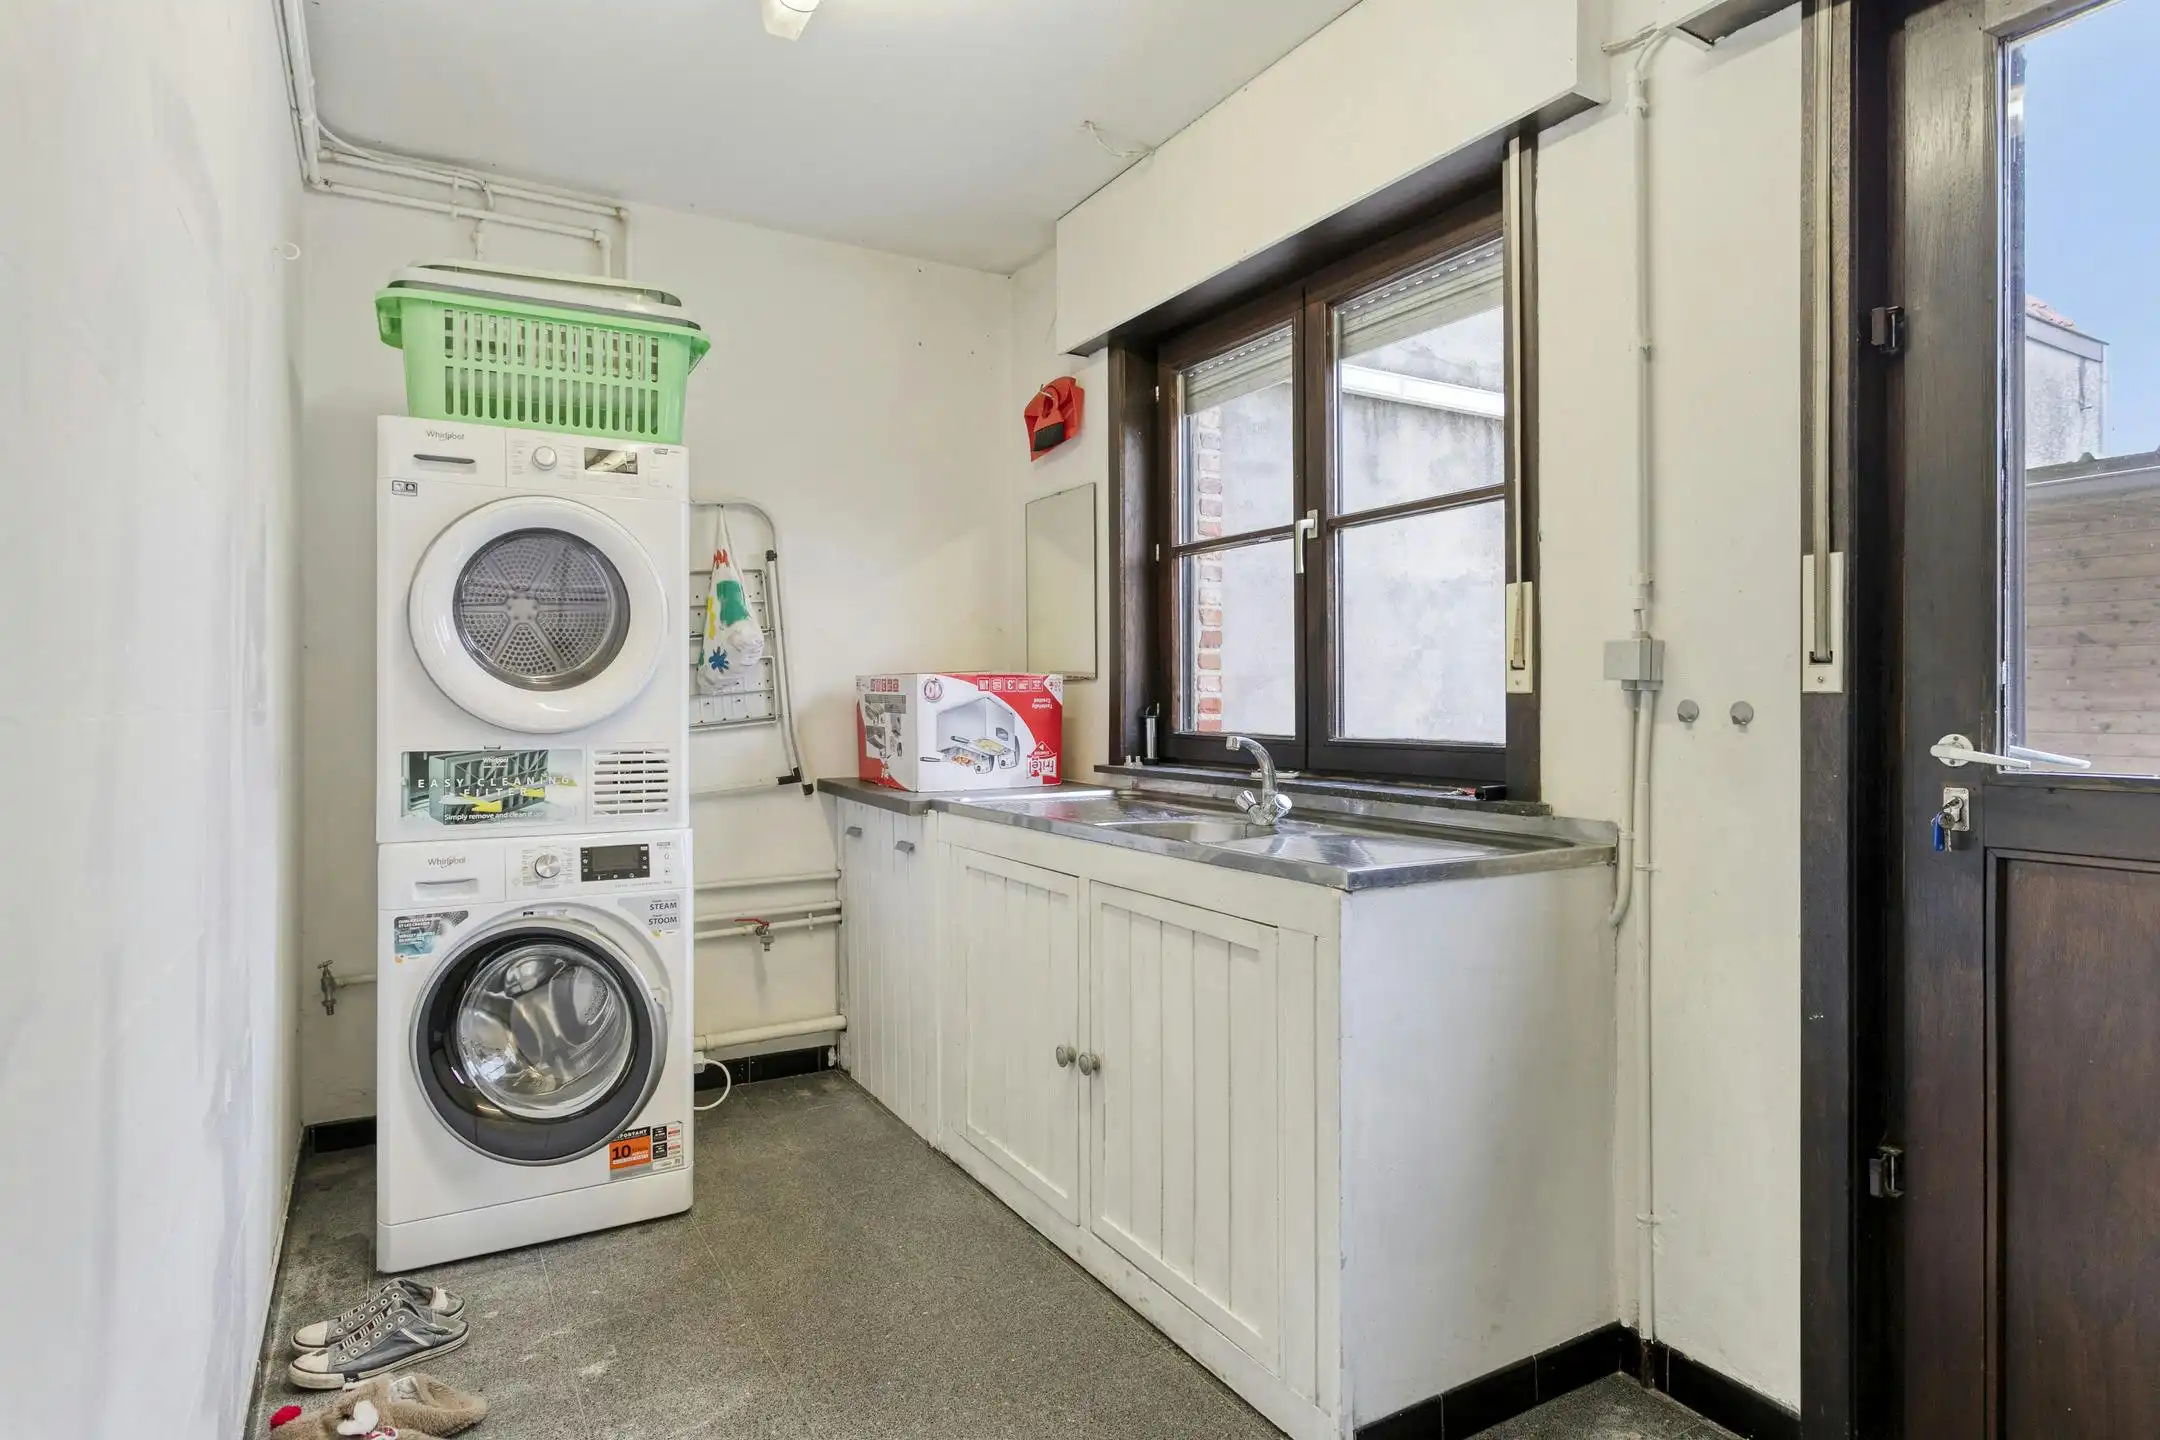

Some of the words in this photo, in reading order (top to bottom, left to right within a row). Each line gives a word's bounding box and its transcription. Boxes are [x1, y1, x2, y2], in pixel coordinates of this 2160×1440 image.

[426, 430, 465, 441] Whirlpool
[417, 778, 464, 788] EASY
[477, 776, 569, 787] CLEANING
[464, 787, 527, 797] FILTER
[444, 813, 468, 821] Simply
[468, 812, 495, 820] remove
[427, 856, 466, 867] Whirlpool
[649, 902, 677, 911] STEAM
[648, 916, 677, 926] STOOM
[612, 1144, 631, 1160] 10
